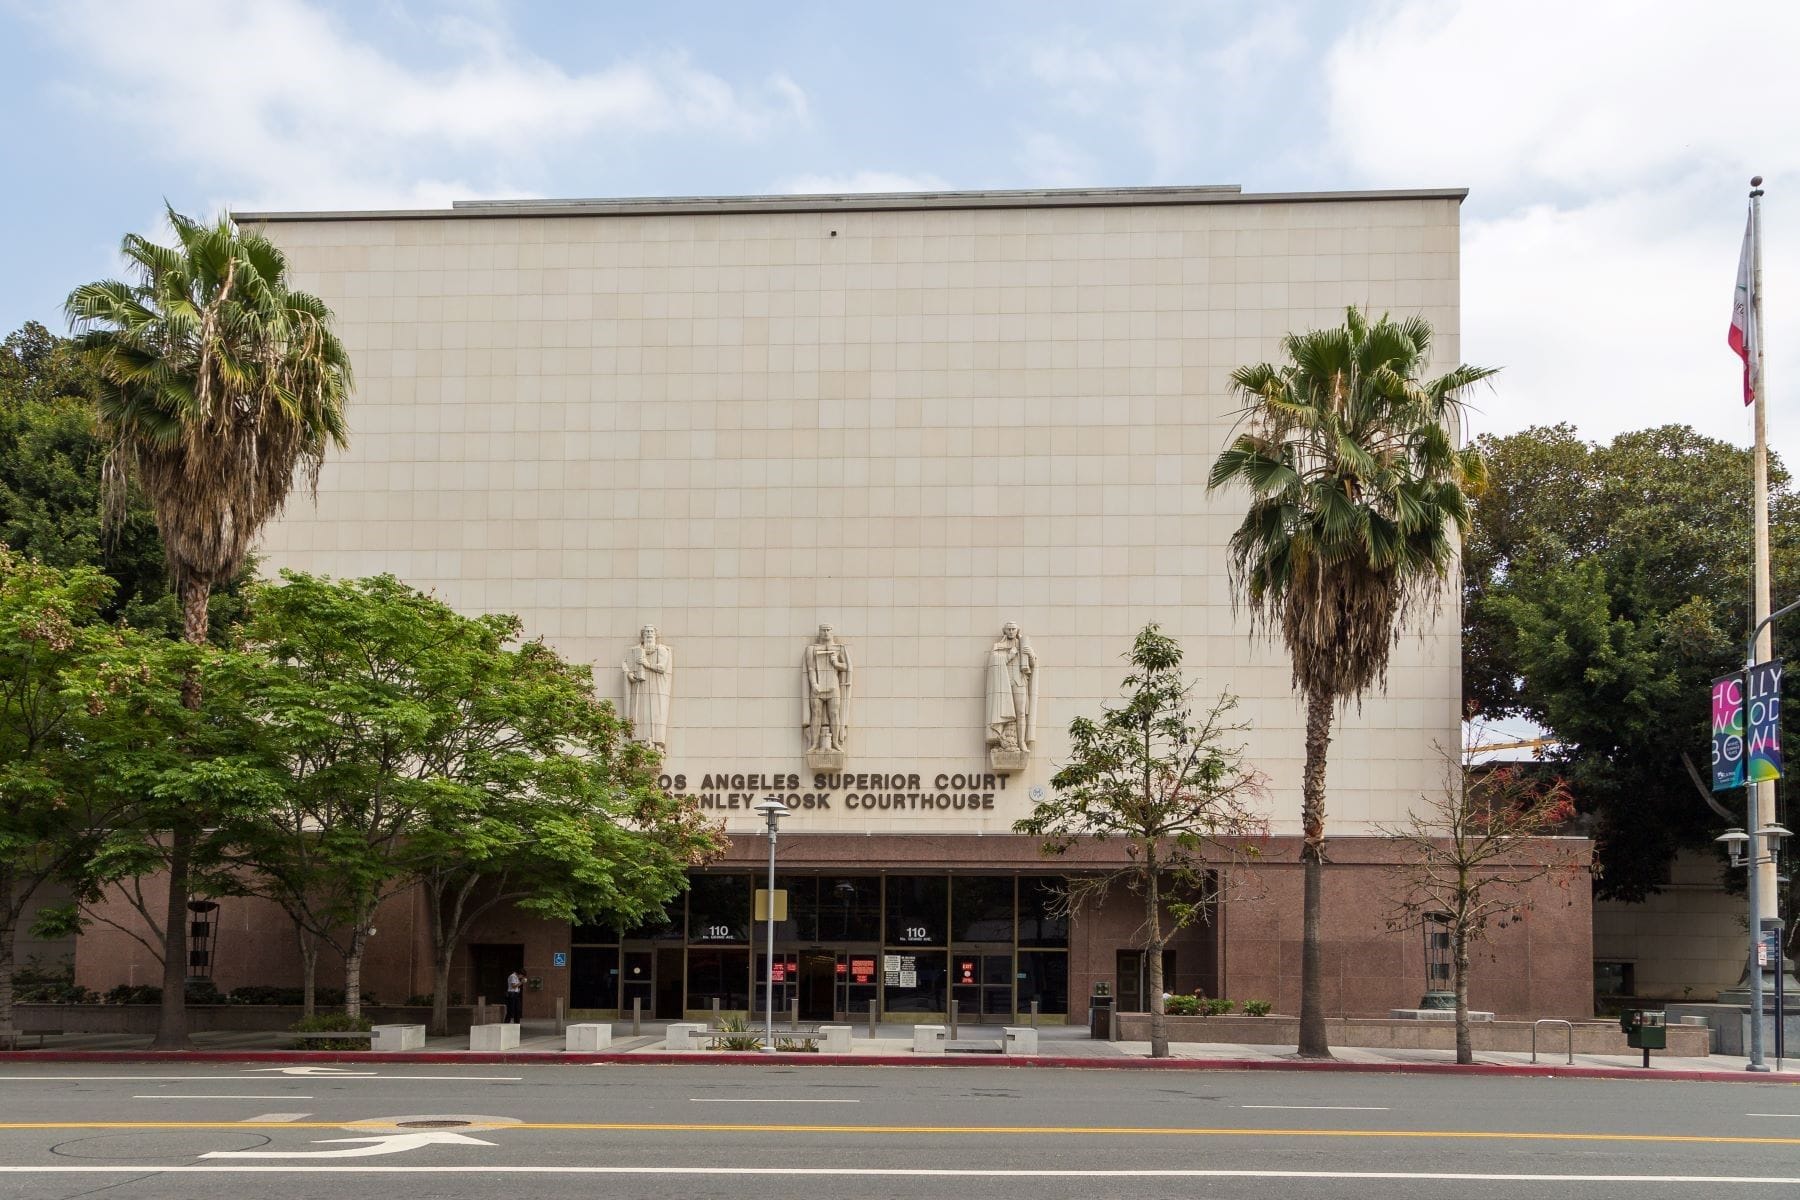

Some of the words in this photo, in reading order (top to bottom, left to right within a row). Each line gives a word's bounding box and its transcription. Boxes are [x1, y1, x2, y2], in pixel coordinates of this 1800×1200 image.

[657, 774, 687, 790] OS
[701, 773, 800, 790] ANGELES
[814, 773, 921, 790] SUPERIOR
[935, 773, 1010, 790] COURT
[664, 793, 755, 809] NLEY
[845, 793, 995, 809] COURTHOUSE
[709, 925, 729, 936] 110
[906, 927, 926, 938] 110
